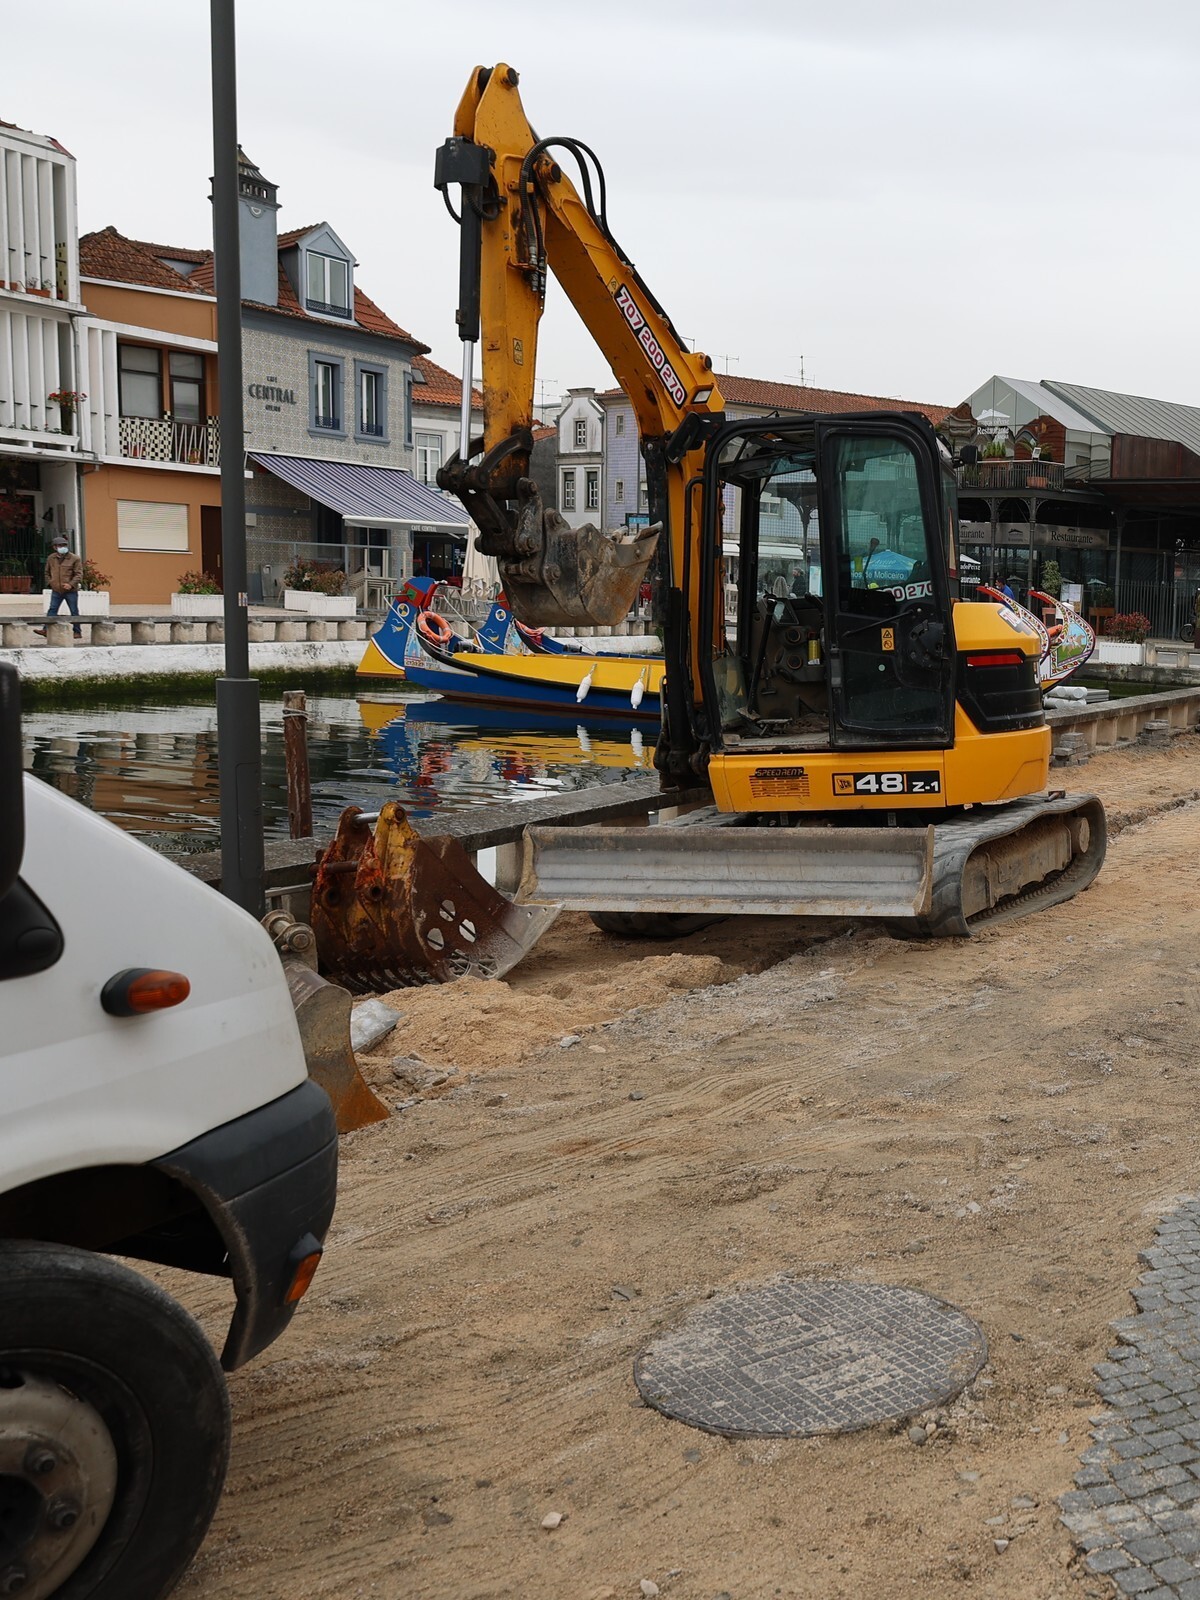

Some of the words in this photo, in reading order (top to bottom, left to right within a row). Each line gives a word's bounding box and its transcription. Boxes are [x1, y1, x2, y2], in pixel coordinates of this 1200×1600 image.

[616, 286, 645, 330] 707
[638, 326, 665, 369] 200
[660, 363, 685, 405] 270
[248, 383, 296, 405] CENTRAL
[959, 529, 985, 539] aurante
[1051, 530, 1094, 544] Restaurante
[874, 570, 905, 579] Moliceiro
[856, 773, 903, 793] 48
[912, 781, 938, 792] Z-1
